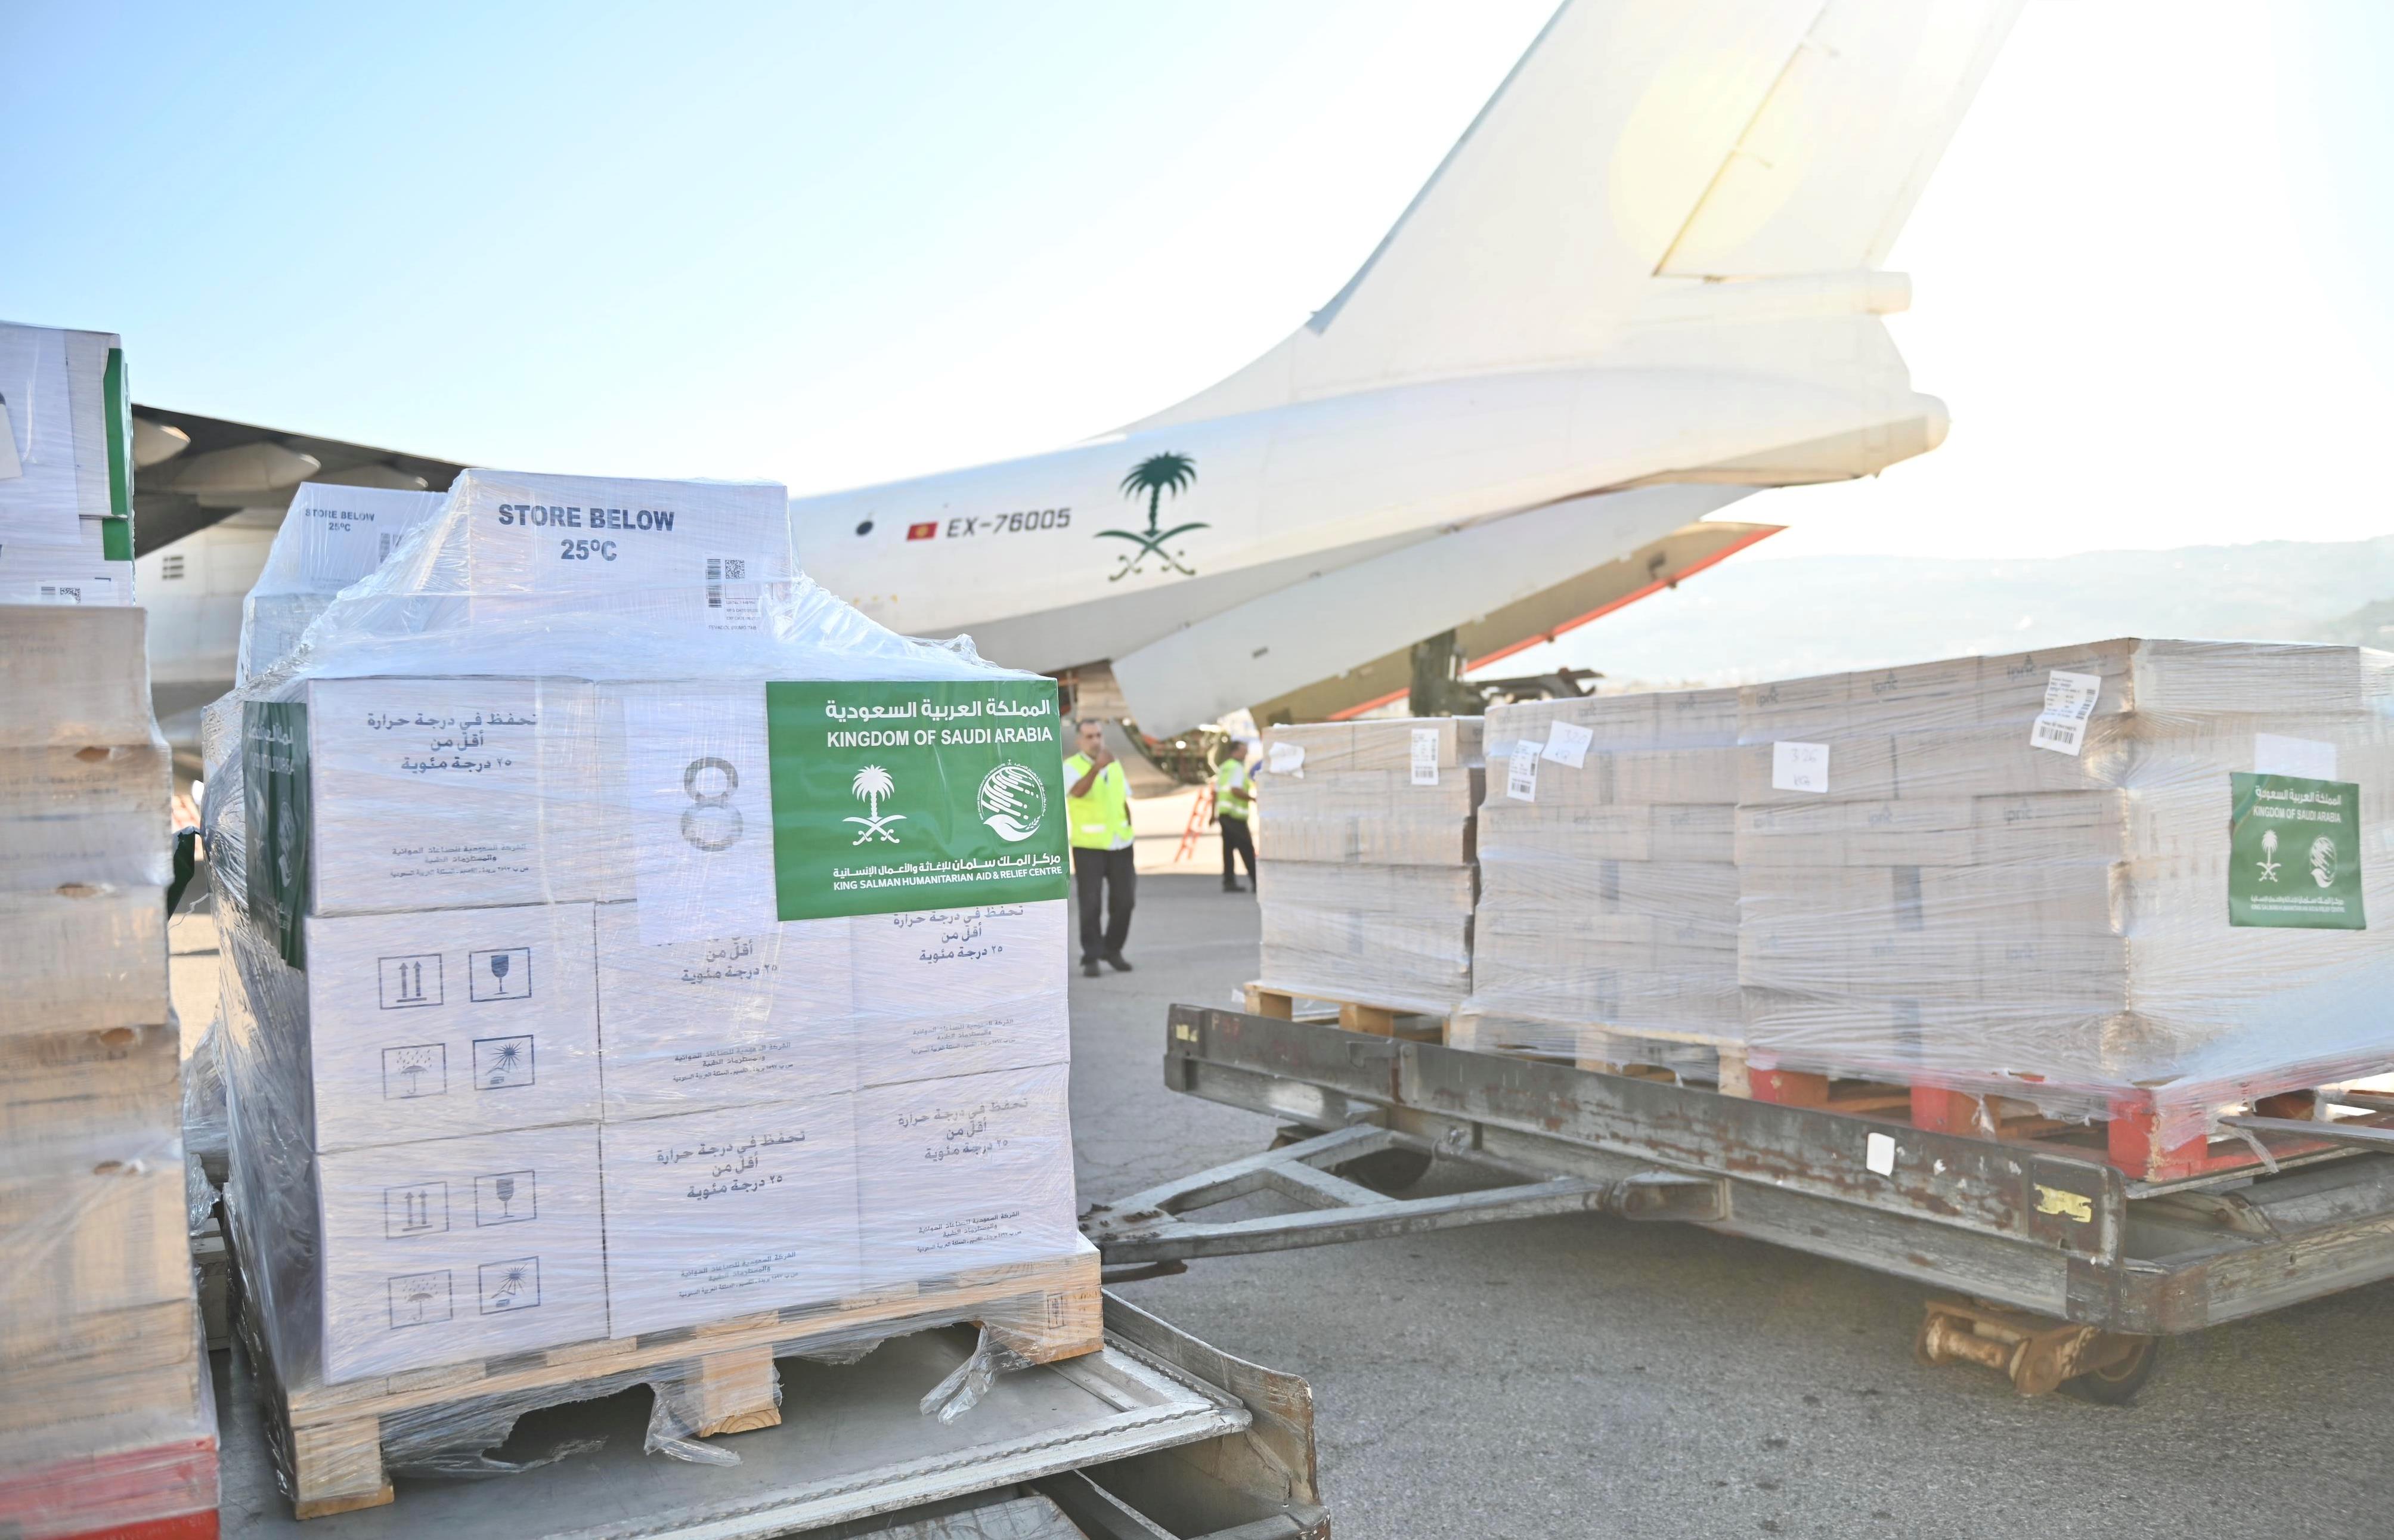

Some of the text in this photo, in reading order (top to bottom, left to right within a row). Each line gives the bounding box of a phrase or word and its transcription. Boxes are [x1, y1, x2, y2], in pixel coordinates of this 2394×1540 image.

[305, 509, 374, 521] STORE BELOW
[498, 504, 674, 531] STORE BELOW
[946, 507, 1070, 538] EX-76005
[825, 698, 1050, 723] المملكة العربية السعودية
[367, 713, 410, 729] حرارة
[414, 712, 455, 729] درجة
[460, 712, 482, 730] في
[431, 736, 453, 751] من
[828, 726, 1053, 748] KINGDOM OF SAUDI ARABIA
[401, 756, 447, 773] مئوية
[451, 757, 491, 772] درجة
[2289, 788, 2314, 804] العربية
[2315, 791, 2341, 805] المملكة
[2253, 806, 2341, 823] KINGDOM OF SAUDI ARABIA
[952, 857, 995, 872] سلمان
[997, 854, 1030, 867] الملك
[1032, 853, 1061, 867] مركز
[834, 866, 1062, 891] KING SALMAN HUMANITARIAN AID & RELIEF CENTRE
[894, 906, 1023, 928] تحفظ في درجة حرارة
[942, 931, 959, 943] من
[707, 949, 726, 962] من
[919, 945, 1003, 964] ٢٥ درجة مئوية
[682, 968, 721, 984] مئوية
[725, 965, 760, 980] درجة
[899, 1098, 1028, 1127] تحفظ في درجة حرارة
[946, 1127, 964, 1140] من
[657, 1131, 806, 1164] تحفظ في درجة حرارة
[925, 1146, 959, 1161] مئوية
[963, 1142, 992, 1154] درجة
[712, 1163, 732, 1178] من
[687, 1174, 783, 1201] ٢٥ درجة مئوية
[973, 1215, 998, 1223] السعودية
